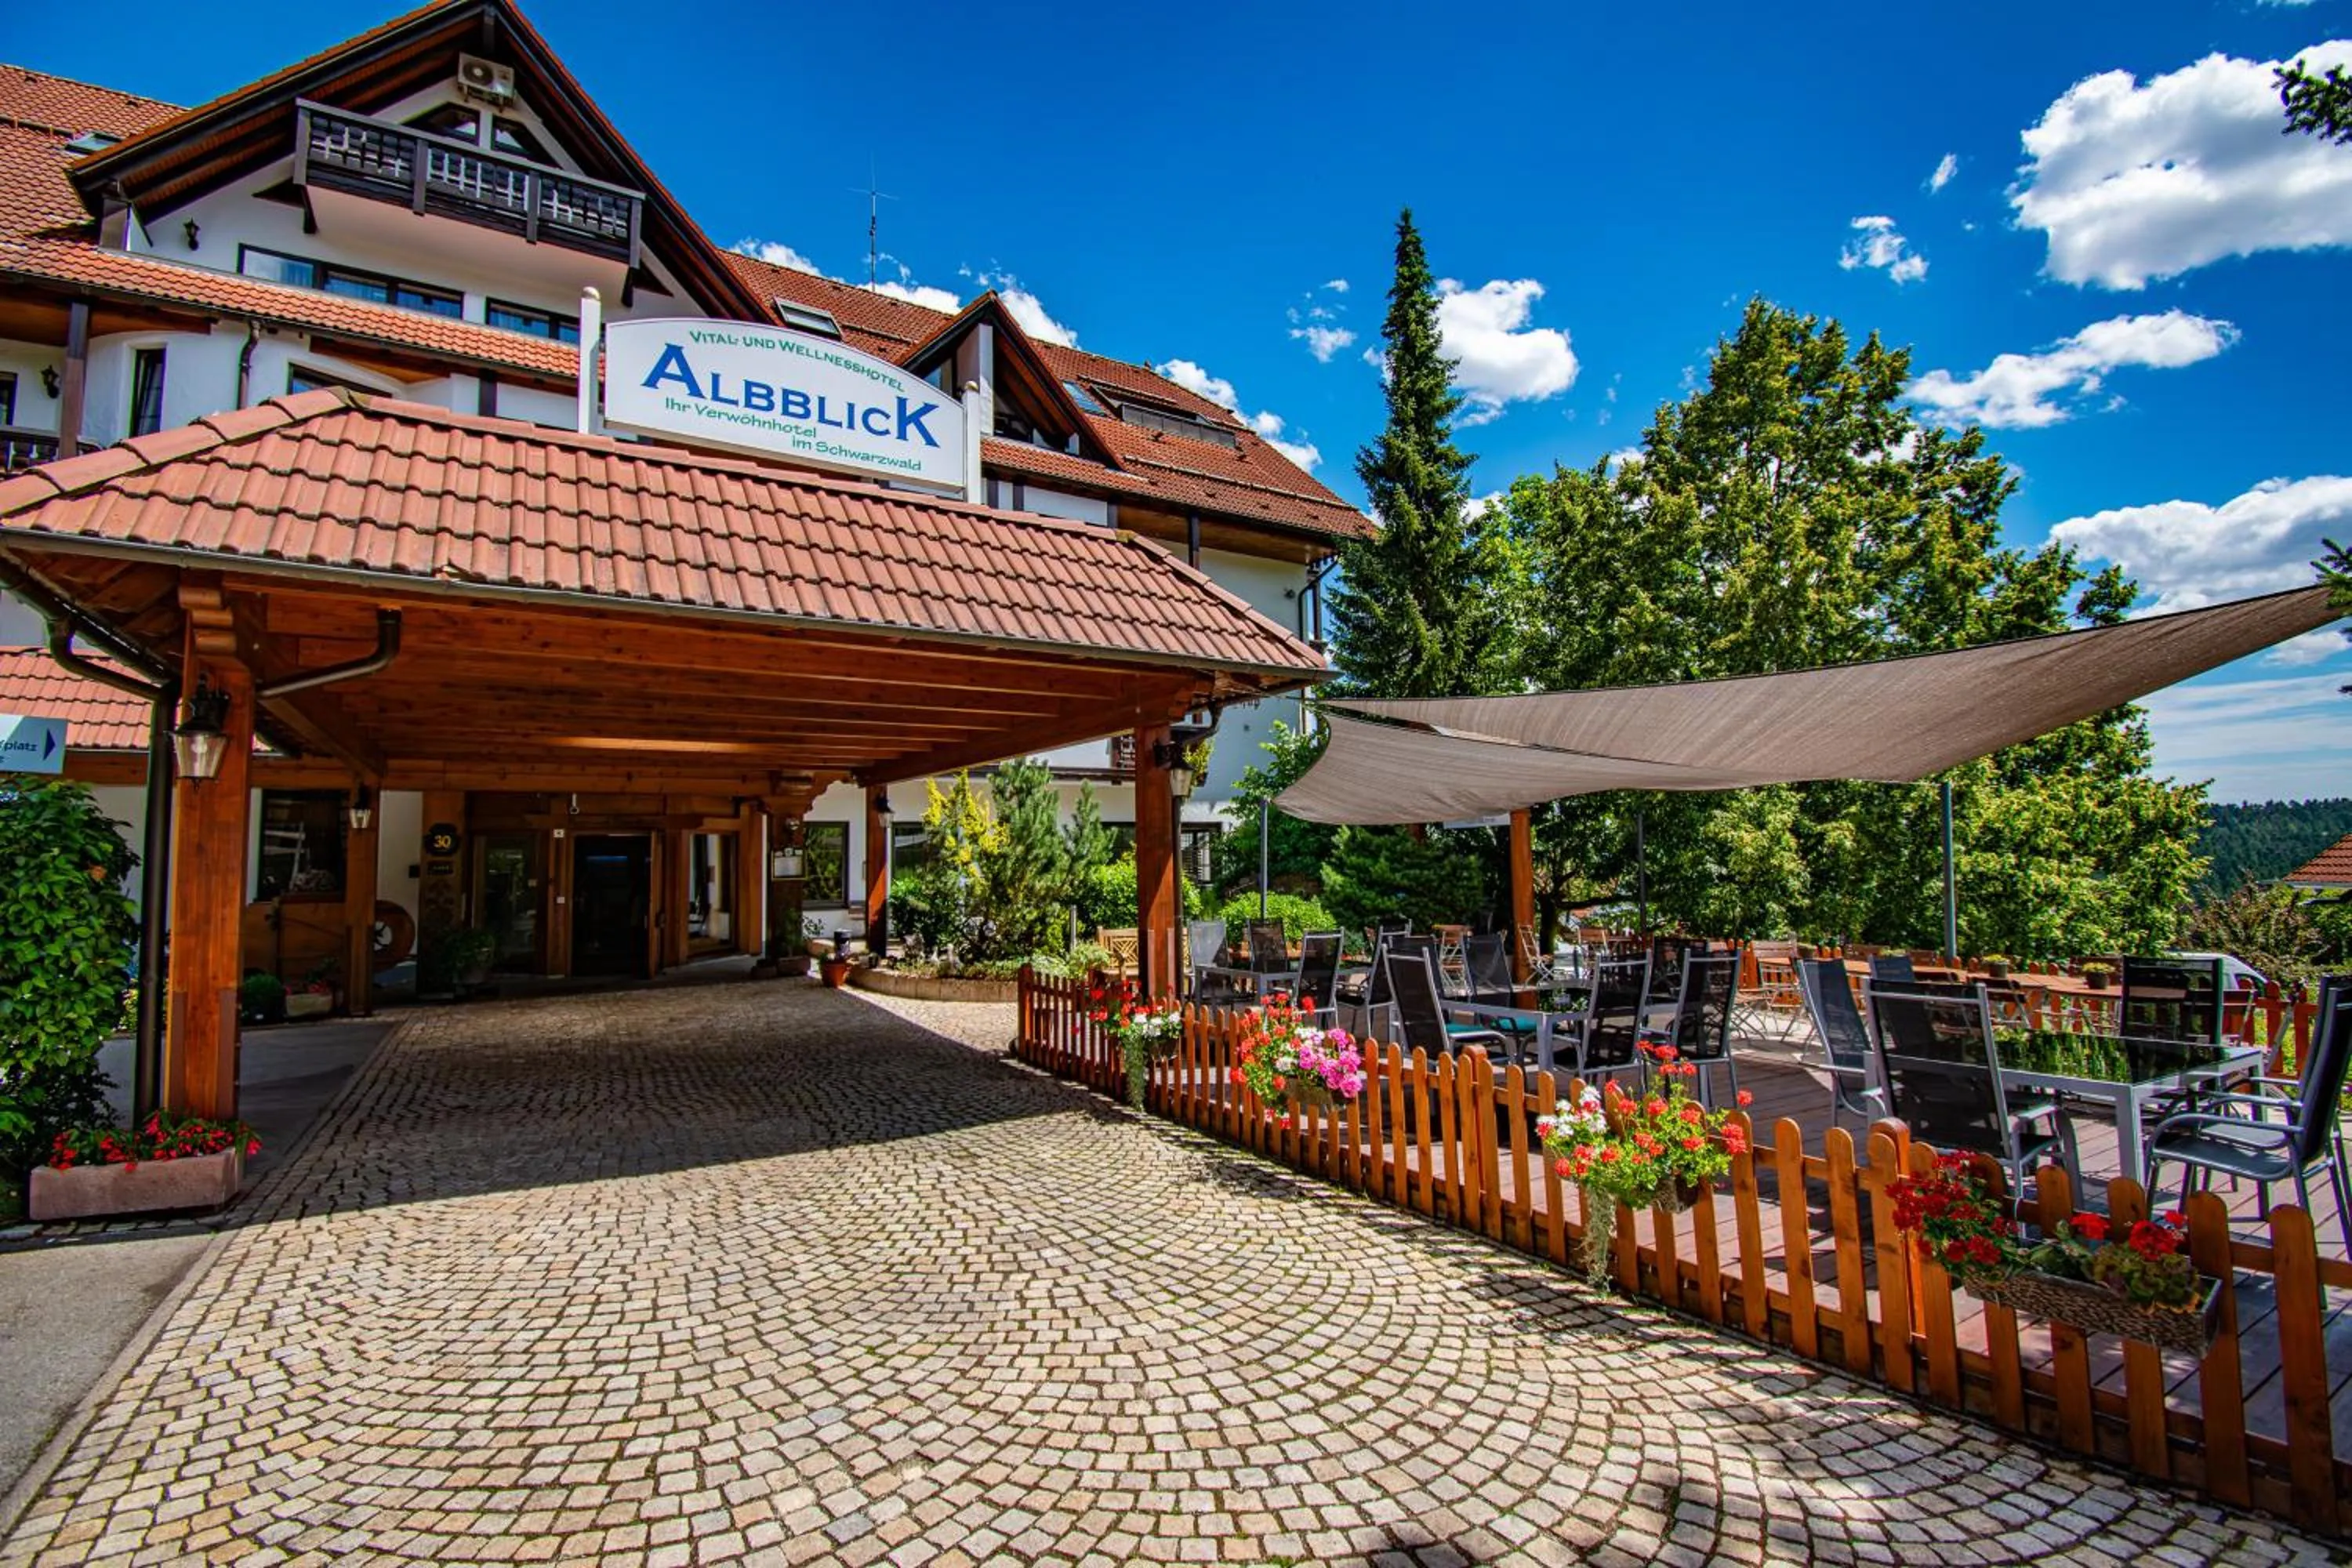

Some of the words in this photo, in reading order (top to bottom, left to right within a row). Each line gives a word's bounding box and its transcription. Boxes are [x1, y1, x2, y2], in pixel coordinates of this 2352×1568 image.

[742, 336, 775, 349] UND
[779, 339, 906, 392] WELLNESSHOTEL
[641, 343, 940, 448] ALBBLICK
[666, 397, 691, 412] Ihr
[695, 403, 816, 438] Verwöhnhotel
[792, 436, 811, 450] im
[816, 441, 922, 471] Schwarzwald
[434, 835, 452, 848] 30
